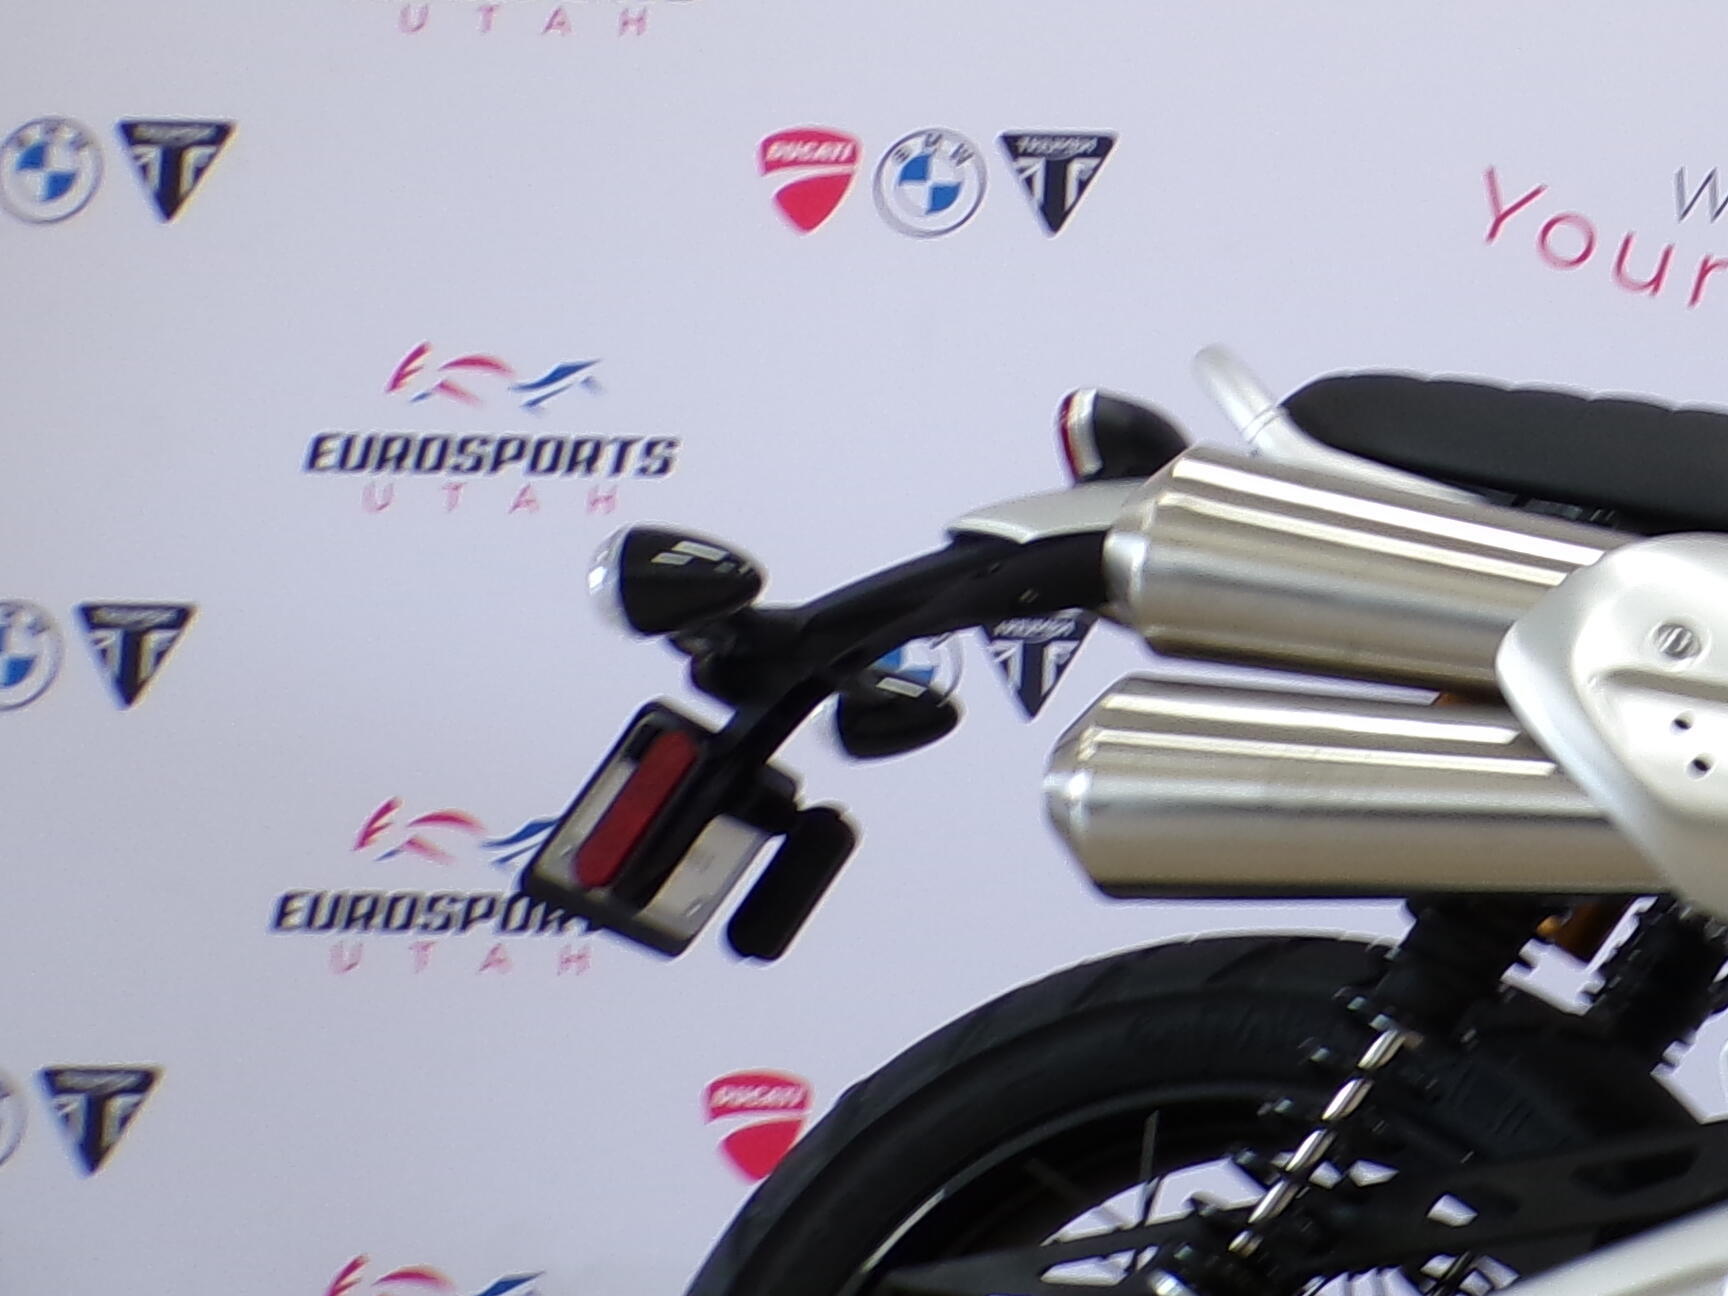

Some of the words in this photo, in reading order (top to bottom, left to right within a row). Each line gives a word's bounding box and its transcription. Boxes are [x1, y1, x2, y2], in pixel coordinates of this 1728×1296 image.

[397, 4, 649, 36] UTAH
[767, 140, 854, 163] DUCATI
[305, 432, 679, 477] EUROSPORTS
[363, 481, 619, 514] UTAH
[329, 940, 591, 976] UTAH
